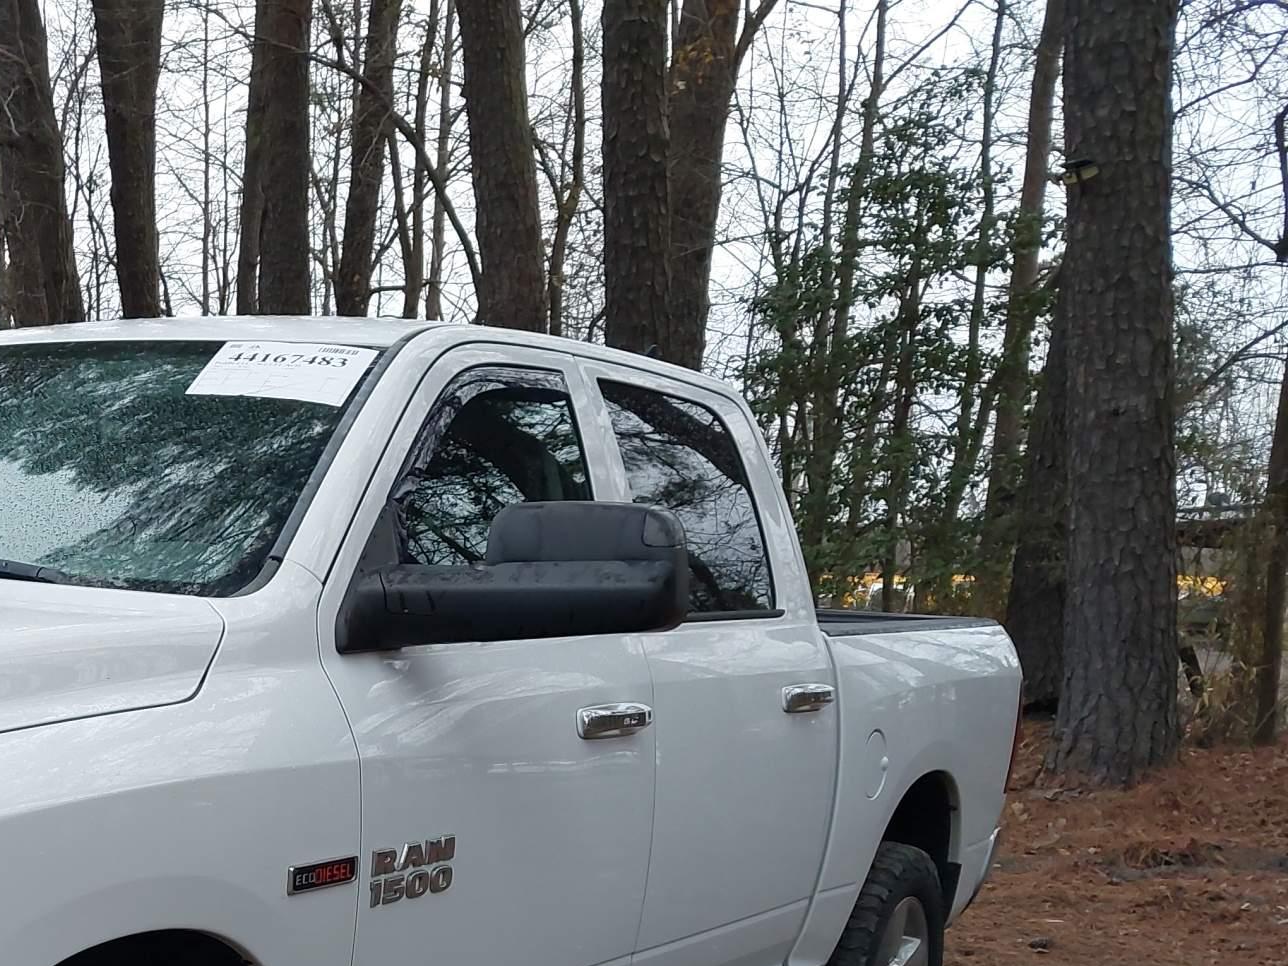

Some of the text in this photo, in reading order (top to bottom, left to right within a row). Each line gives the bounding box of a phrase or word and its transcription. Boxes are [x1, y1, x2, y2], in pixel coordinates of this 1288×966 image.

[228, 351, 348, 368] 44167483
[371, 834, 456, 878] RAM
[295, 863, 353, 886] ECODIESEL
[369, 864, 454, 909] 1500
